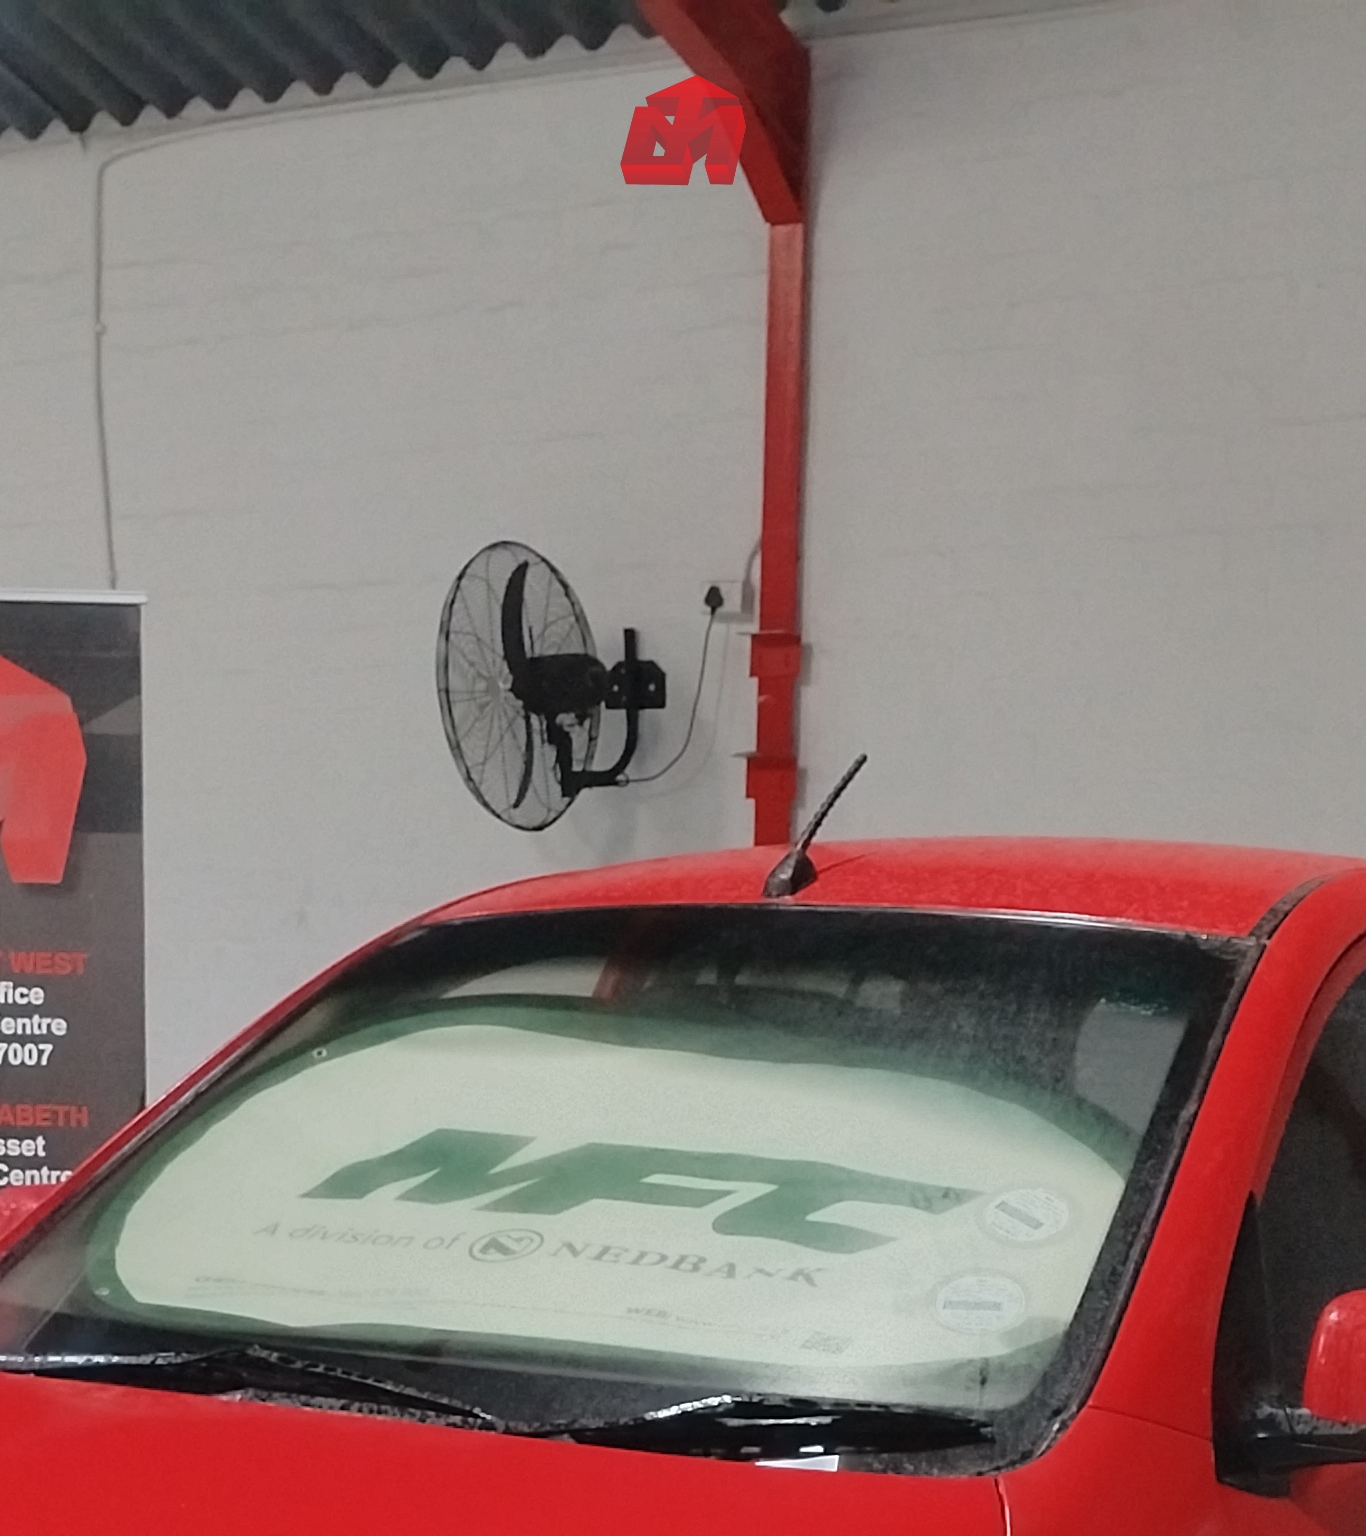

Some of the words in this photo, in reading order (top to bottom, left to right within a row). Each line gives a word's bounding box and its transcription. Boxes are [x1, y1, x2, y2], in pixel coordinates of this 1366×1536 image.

[8, 951, 85, 975] WEST
[287, 1224, 415, 1247] division
[422, 1231, 467, 1250] of
[550, 1240, 828, 1287] NEDBANK
